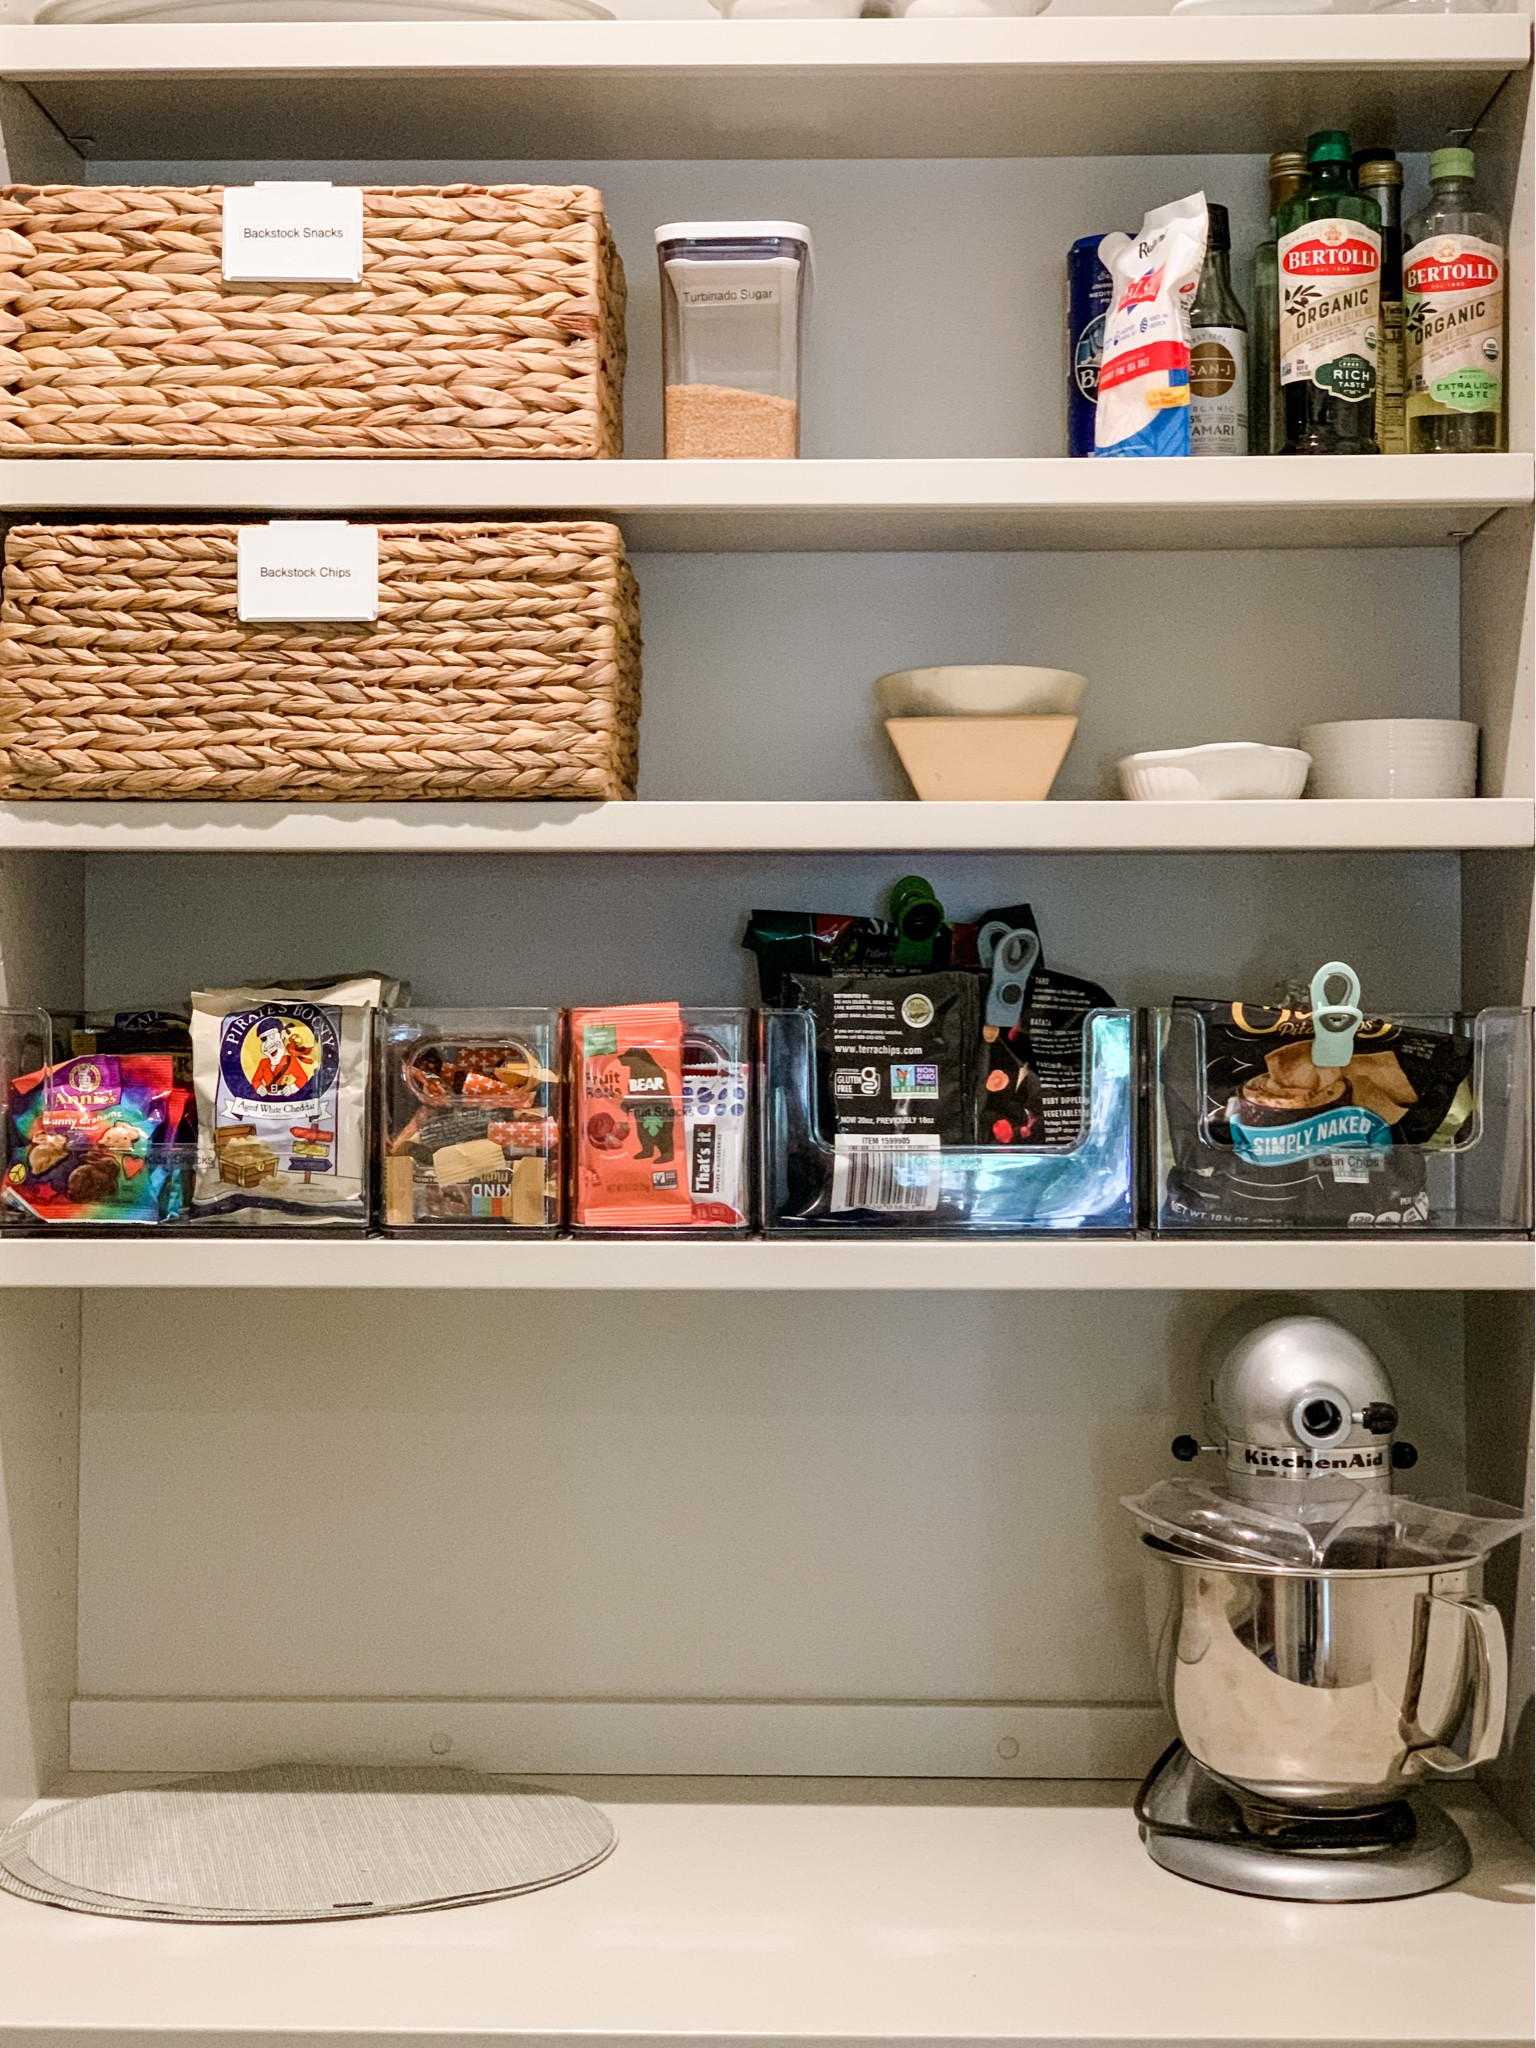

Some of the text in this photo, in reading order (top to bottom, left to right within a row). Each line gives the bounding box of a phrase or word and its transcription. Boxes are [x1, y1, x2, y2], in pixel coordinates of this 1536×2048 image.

[244, 227, 344, 238] Backstock Snacks
[1288, 248, 1375, 270] BERTOLLI
[1407, 263, 1493, 288] BERTOLLI
[683, 289, 773, 302] Turbinado Sugar
[1296, 288, 1368, 329] ORGANIC
[1415, 301, 1485, 345] ORGANIC
[1190, 364, 1231, 376] SAN-J
[1333, 369, 1370, 381] RICH
[1338, 381, 1365, 389] TASTE
[1436, 382, 1472, 391] EXTRA
[1474, 382, 1498, 390] LIGHT
[1190, 424, 1234, 436] AMARI
[260, 566, 352, 578] Backstock Chips
[292, 1004, 335, 1047] BOOTY
[834, 1044, 923, 1056] www.terrachips.com
[586, 1069, 620, 1084] Fruit
[837, 1075, 862, 1084] GLUTEN
[629, 1077, 665, 1092] BEAR
[837, 1084, 853, 1093] FREE
[237, 1101, 316, 1113] Aged White Cheddar
[626, 1106, 695, 1118] Fruit Snacks
[840, 1116, 856, 1124] NOW
[876, 1116, 917, 1124] PREVIOUSLY
[862, 1136, 879, 1144] ITEM
[1253, 1116, 1372, 1156] SIMPLY NAKED
[1315, 1155, 1379, 1169] Open Chips
[695, 1147, 712, 1191] That's
[471, 1184, 512, 1197] KIND
[1244, 1448, 1383, 1469] KitchenAid
